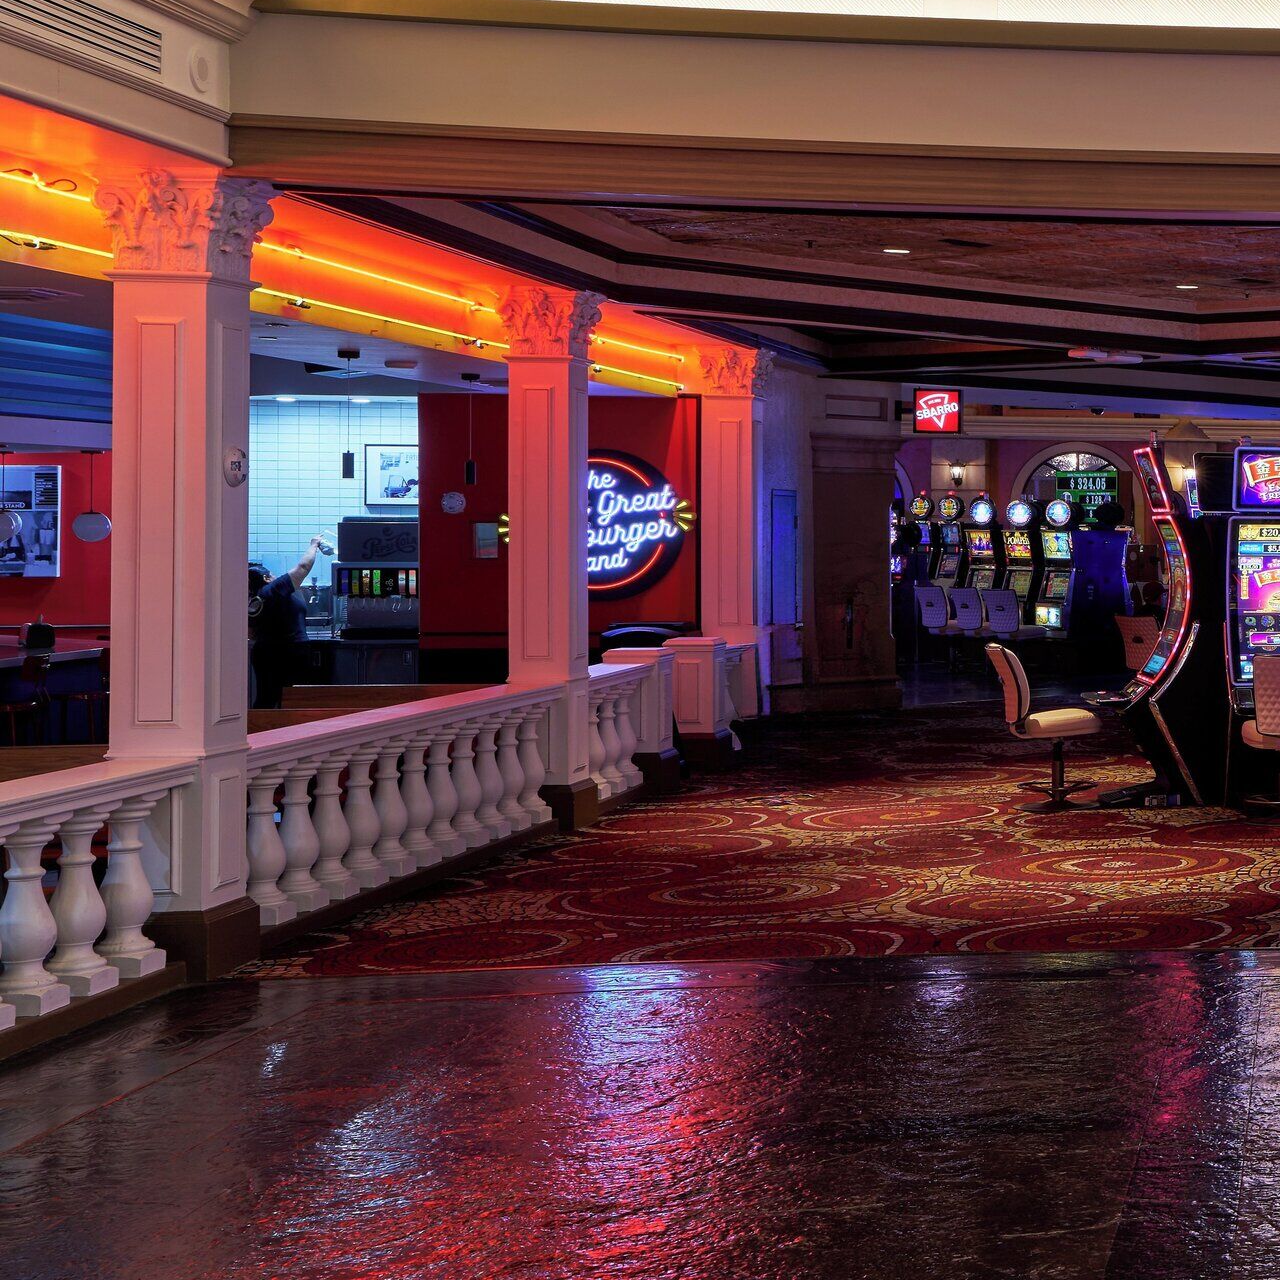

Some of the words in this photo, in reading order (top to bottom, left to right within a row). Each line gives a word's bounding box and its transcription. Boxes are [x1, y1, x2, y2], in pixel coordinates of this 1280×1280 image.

[916, 402, 959, 420] SBARRO
[587, 470, 616, 489] he
[597, 484, 676, 525] Great
[587, 547, 628, 571] and
